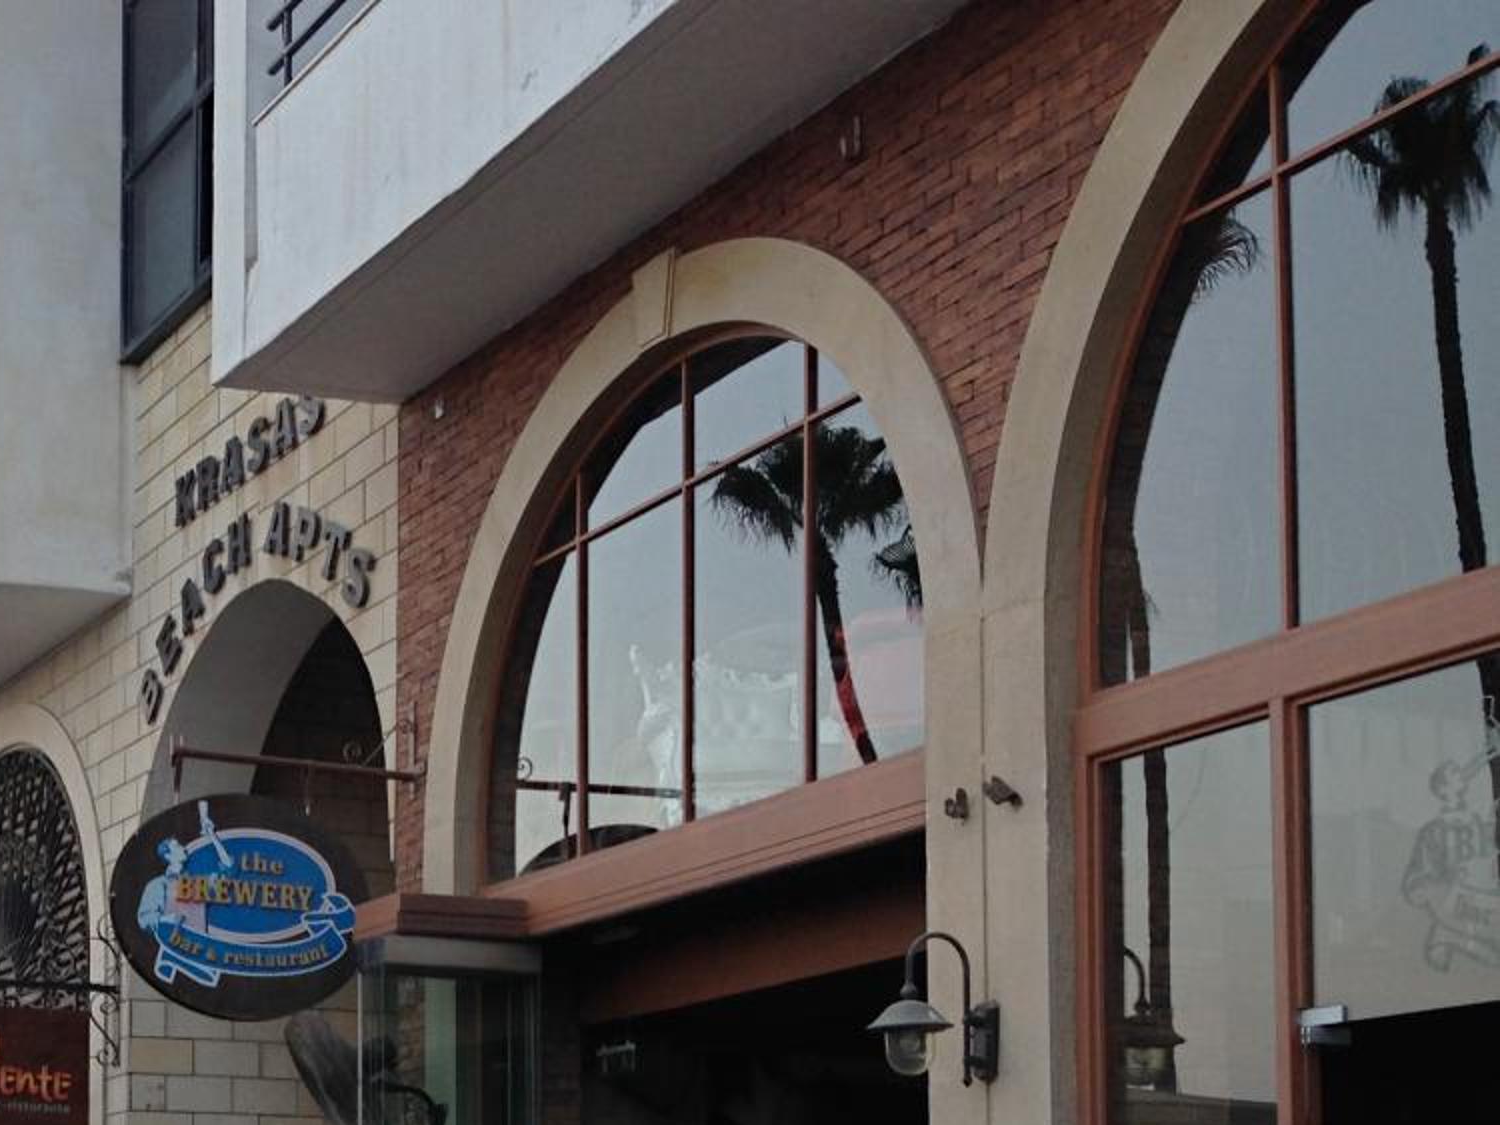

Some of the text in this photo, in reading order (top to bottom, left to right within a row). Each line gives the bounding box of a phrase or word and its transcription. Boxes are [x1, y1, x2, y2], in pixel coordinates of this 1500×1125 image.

[174, 395, 326, 528] KRASAS
[141, 510, 254, 726] BEACH
[241, 852, 285, 876] the
